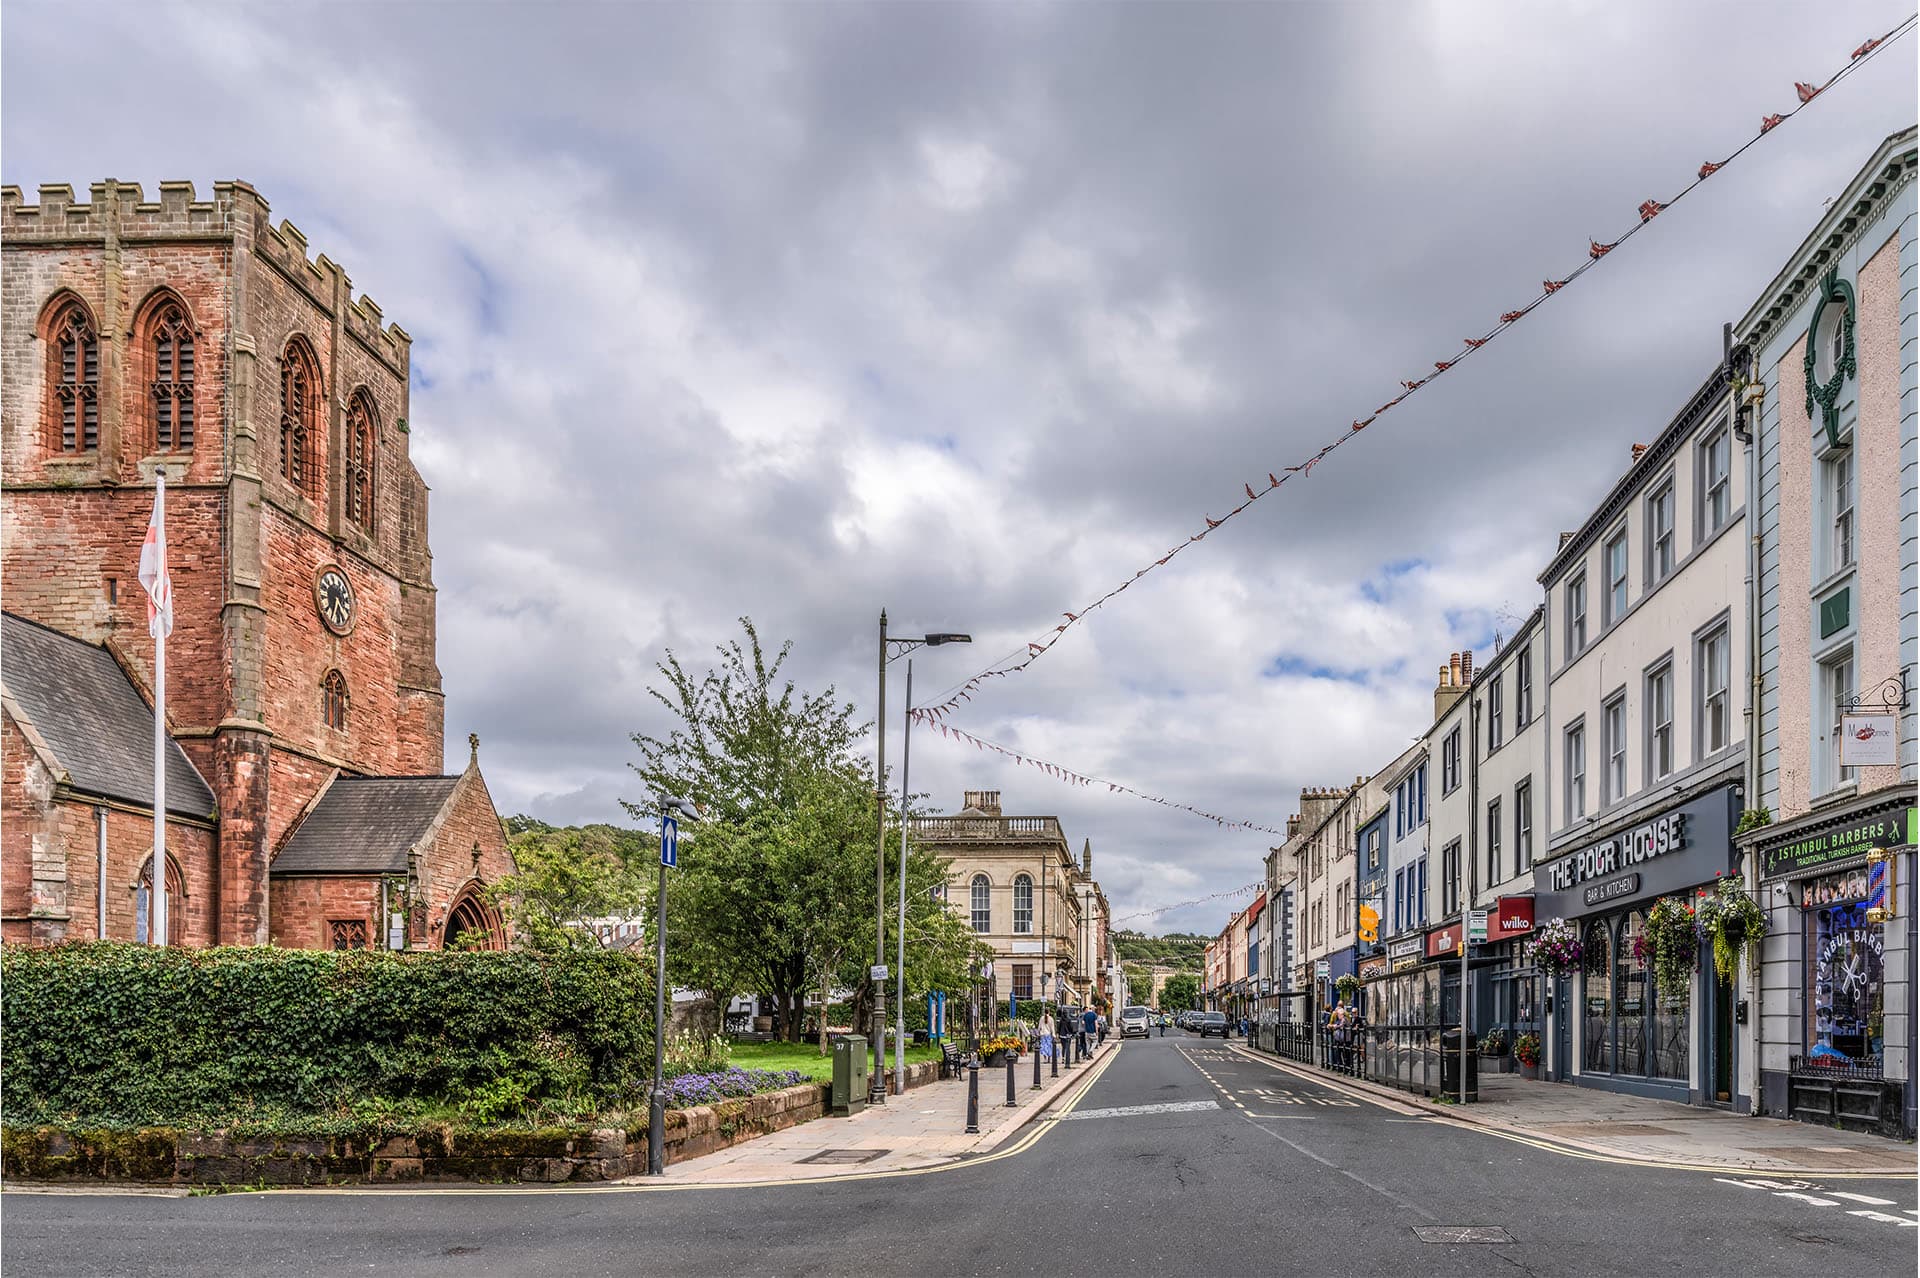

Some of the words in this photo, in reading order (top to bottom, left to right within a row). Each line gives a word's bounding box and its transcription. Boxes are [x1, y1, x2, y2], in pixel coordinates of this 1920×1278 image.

[1548, 858, 1572, 892] THE
[1577, 840, 1615, 882] POUR
[1623, 813, 1680, 867] HOUSE
[1778, 837, 1828, 861] ISTANBUL
[1831, 822, 1884, 848] BARBERS
[1796, 852, 1828, 867] TRADITIONAL
[1828, 847, 1851, 860] TURKISH
[1850, 841, 1874, 855] BARBER
[1587, 887, 1599, 903] BAR
[1600, 885, 1605, 898] &
[1606, 876, 1633, 897] KITCHEN
[1502, 915, 1530, 929] wilko
